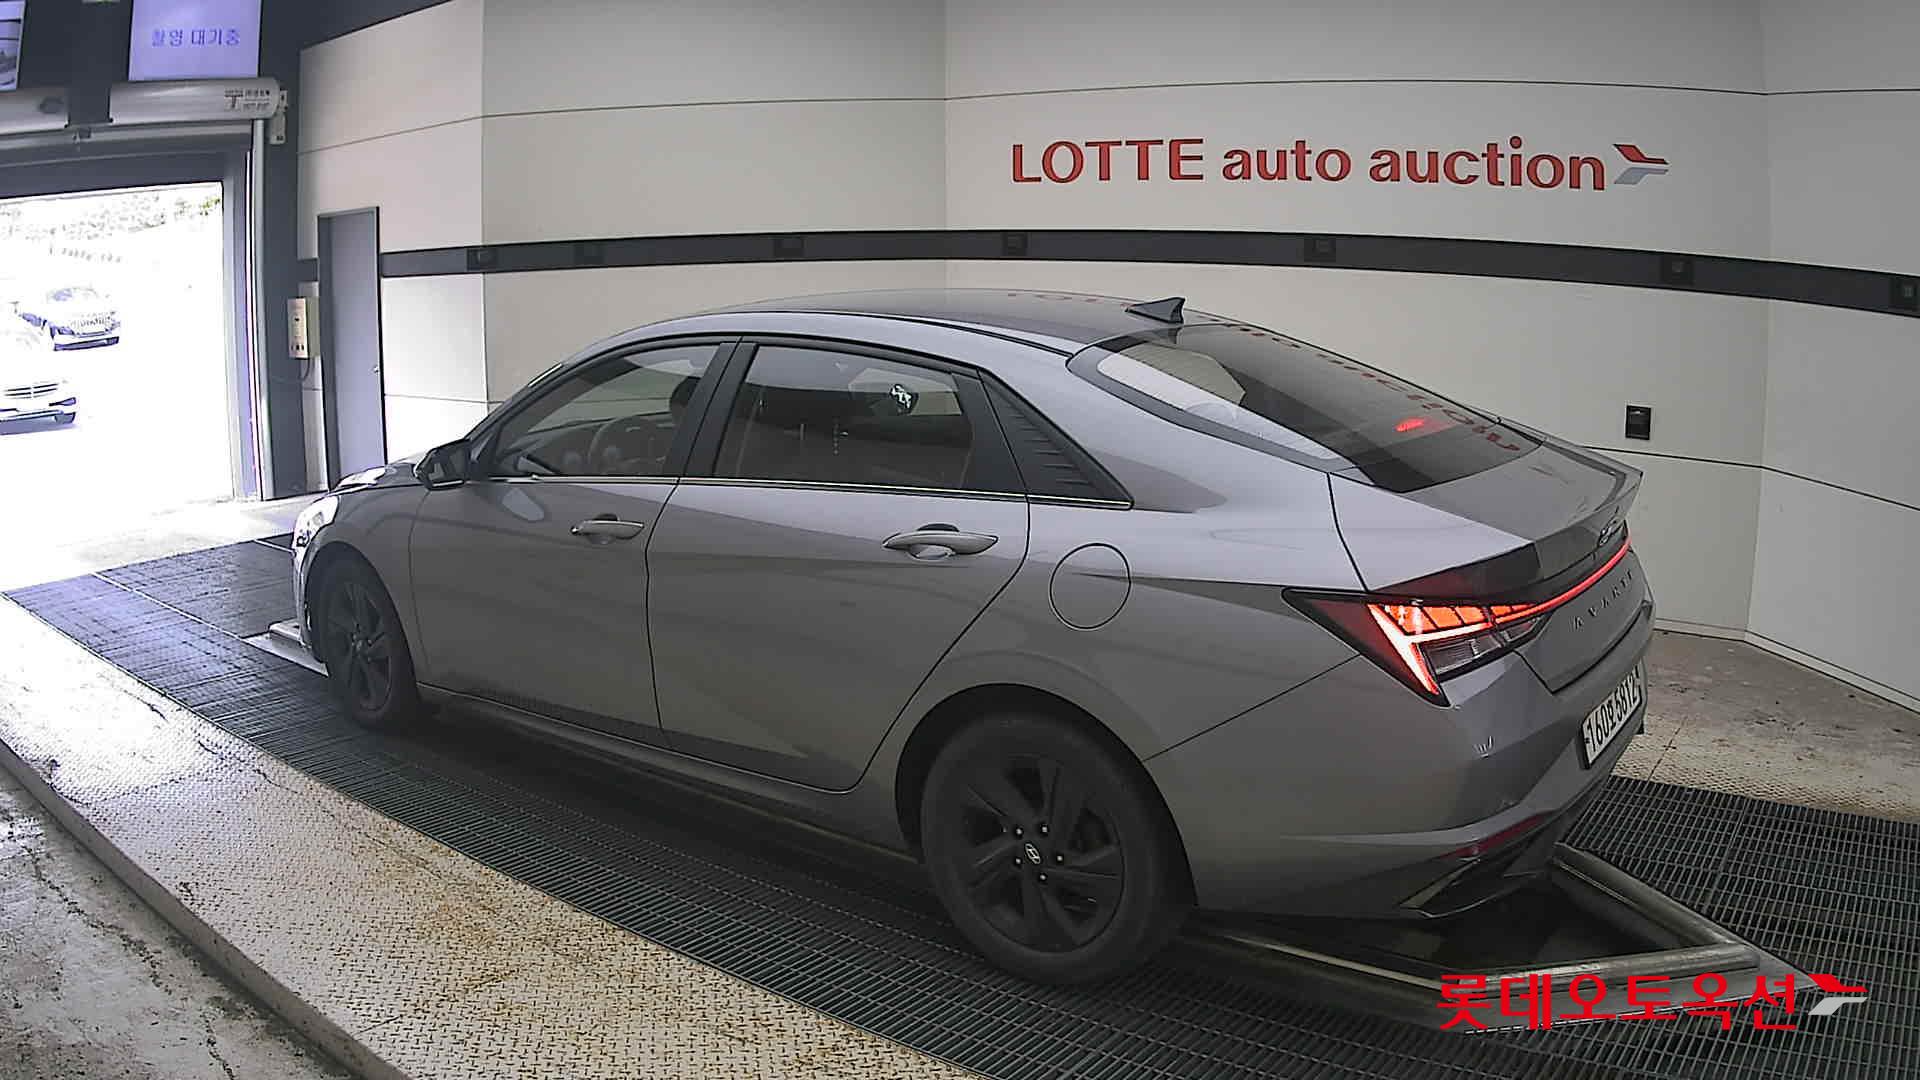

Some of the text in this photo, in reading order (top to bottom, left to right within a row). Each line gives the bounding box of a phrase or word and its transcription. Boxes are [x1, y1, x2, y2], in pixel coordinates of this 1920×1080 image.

[191, 28, 240, 47] 대기중
[1011, 135, 1606, 192] LOTTE auto auction
